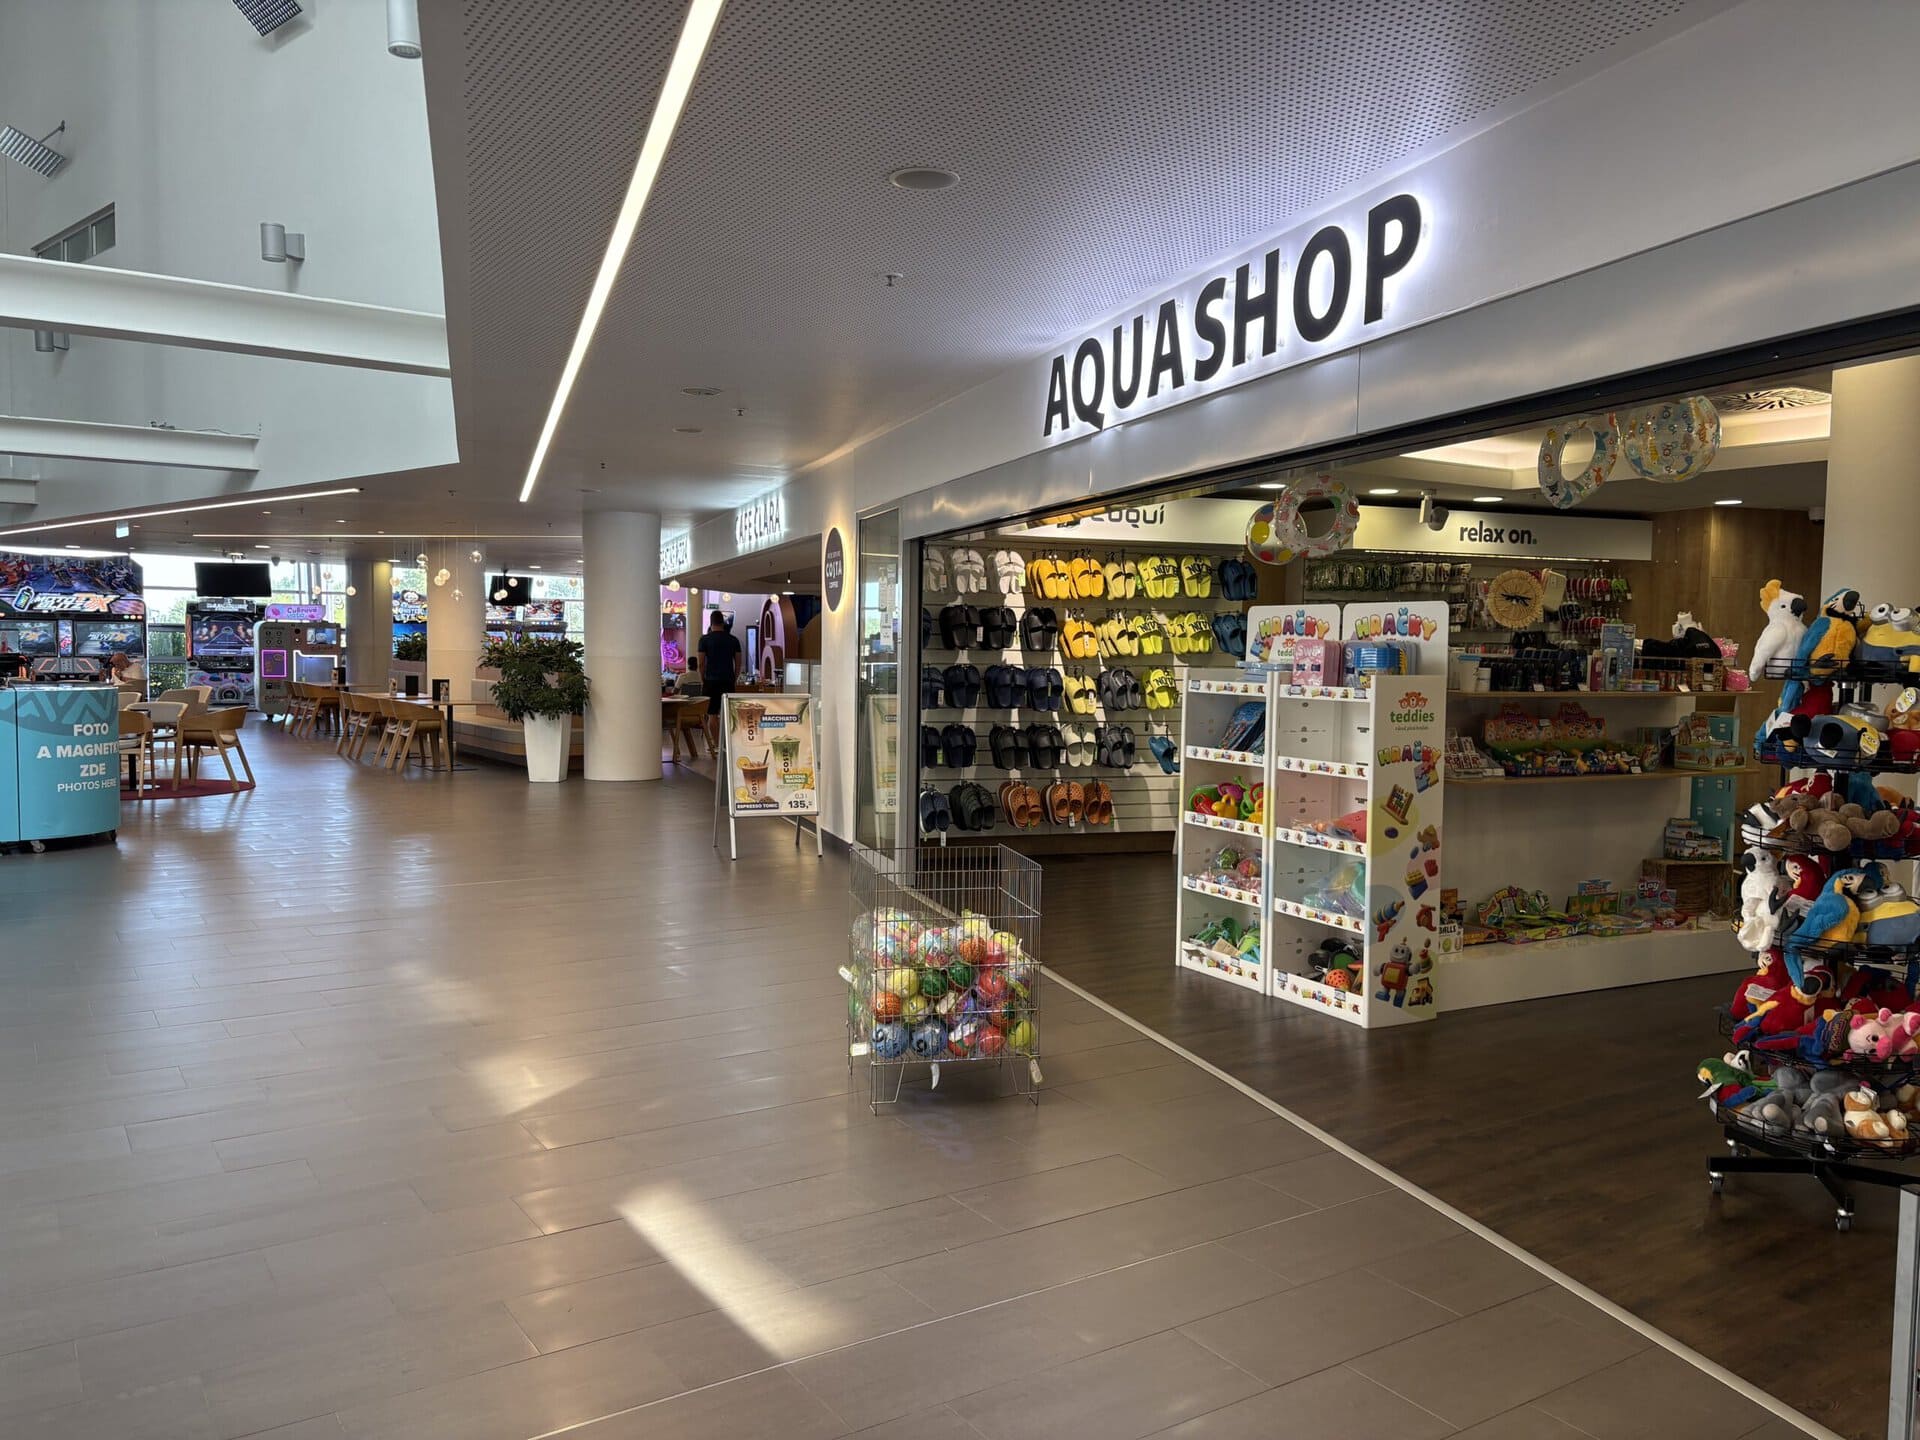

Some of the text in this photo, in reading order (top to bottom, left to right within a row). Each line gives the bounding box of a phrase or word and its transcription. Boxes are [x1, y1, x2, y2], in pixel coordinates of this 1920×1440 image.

[1043, 193, 1423, 437] AQUASHOP
[754, 496, 781, 539] CLARA
[1459, 520, 1537, 545] relax on.
[826, 560, 843, 578] COSTA
[1258, 609, 1330, 640] HRAČKY
[1355, 607, 1438, 641] HRAČKY
[1390, 710, 1435, 723] teddies
[73, 723, 109, 737] FOTO
[36, 746, 51, 759] A
[1376, 740, 1441, 766] HRAČKY
[79, 763, 106, 777] ZDE
[57, 778, 117, 792] PHOTOS HERE
